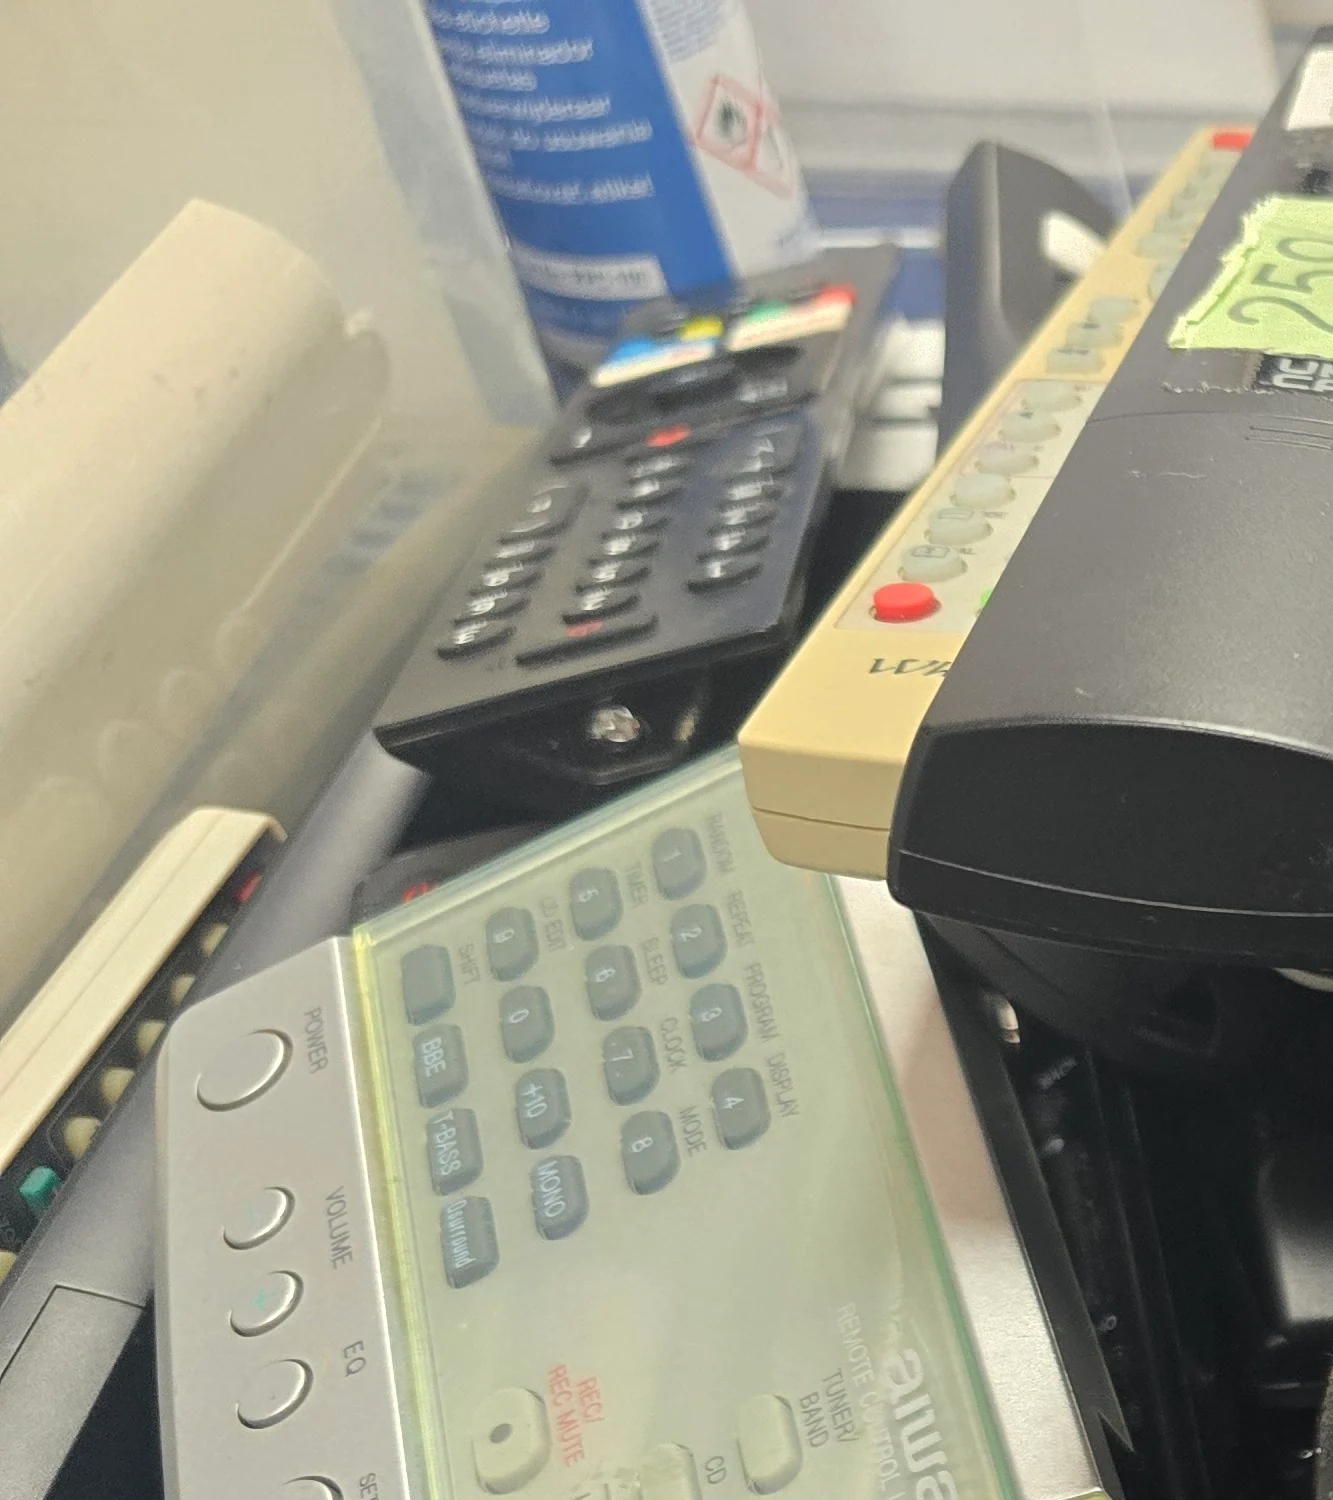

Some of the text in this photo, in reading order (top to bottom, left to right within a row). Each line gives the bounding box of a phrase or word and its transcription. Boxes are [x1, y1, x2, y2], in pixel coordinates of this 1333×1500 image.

[681, 927, 703, 943] 2
[456, 942, 482, 985] SHIFT
[642, 939, 669, 985] SLEEP
[746, 963, 779, 1042] PROGRAM
[303, 1006, 329, 1075] POWER
[422, 1036, 447, 1077] BBE
[662, 1018, 688, 1074] CLOCK
[523, 1084, 548, 1119] +10
[723, 1096, 745, 1110] 4
[766, 1054, 799, 1118] DISPLAY
[431, 1112, 461, 1176] T-BASS
[631, 1135, 653, 1152] 8
[679, 1106, 707, 1156] MODE
[537, 1160, 566, 1218] MONO
[325, 1185, 353, 1271] VOLUME
[343, 1339, 367, 1378] EQ
[838, 1302, 876, 1387] REMOTE
[548, 1364, 586, 1466] REC MUTE
[579, 1376, 604, 1423] REC/
[800, 1392, 828, 1449] BAND
[823, 1368, 861, 1442] TUNER/
[703, 1456, 727, 1485] CD
